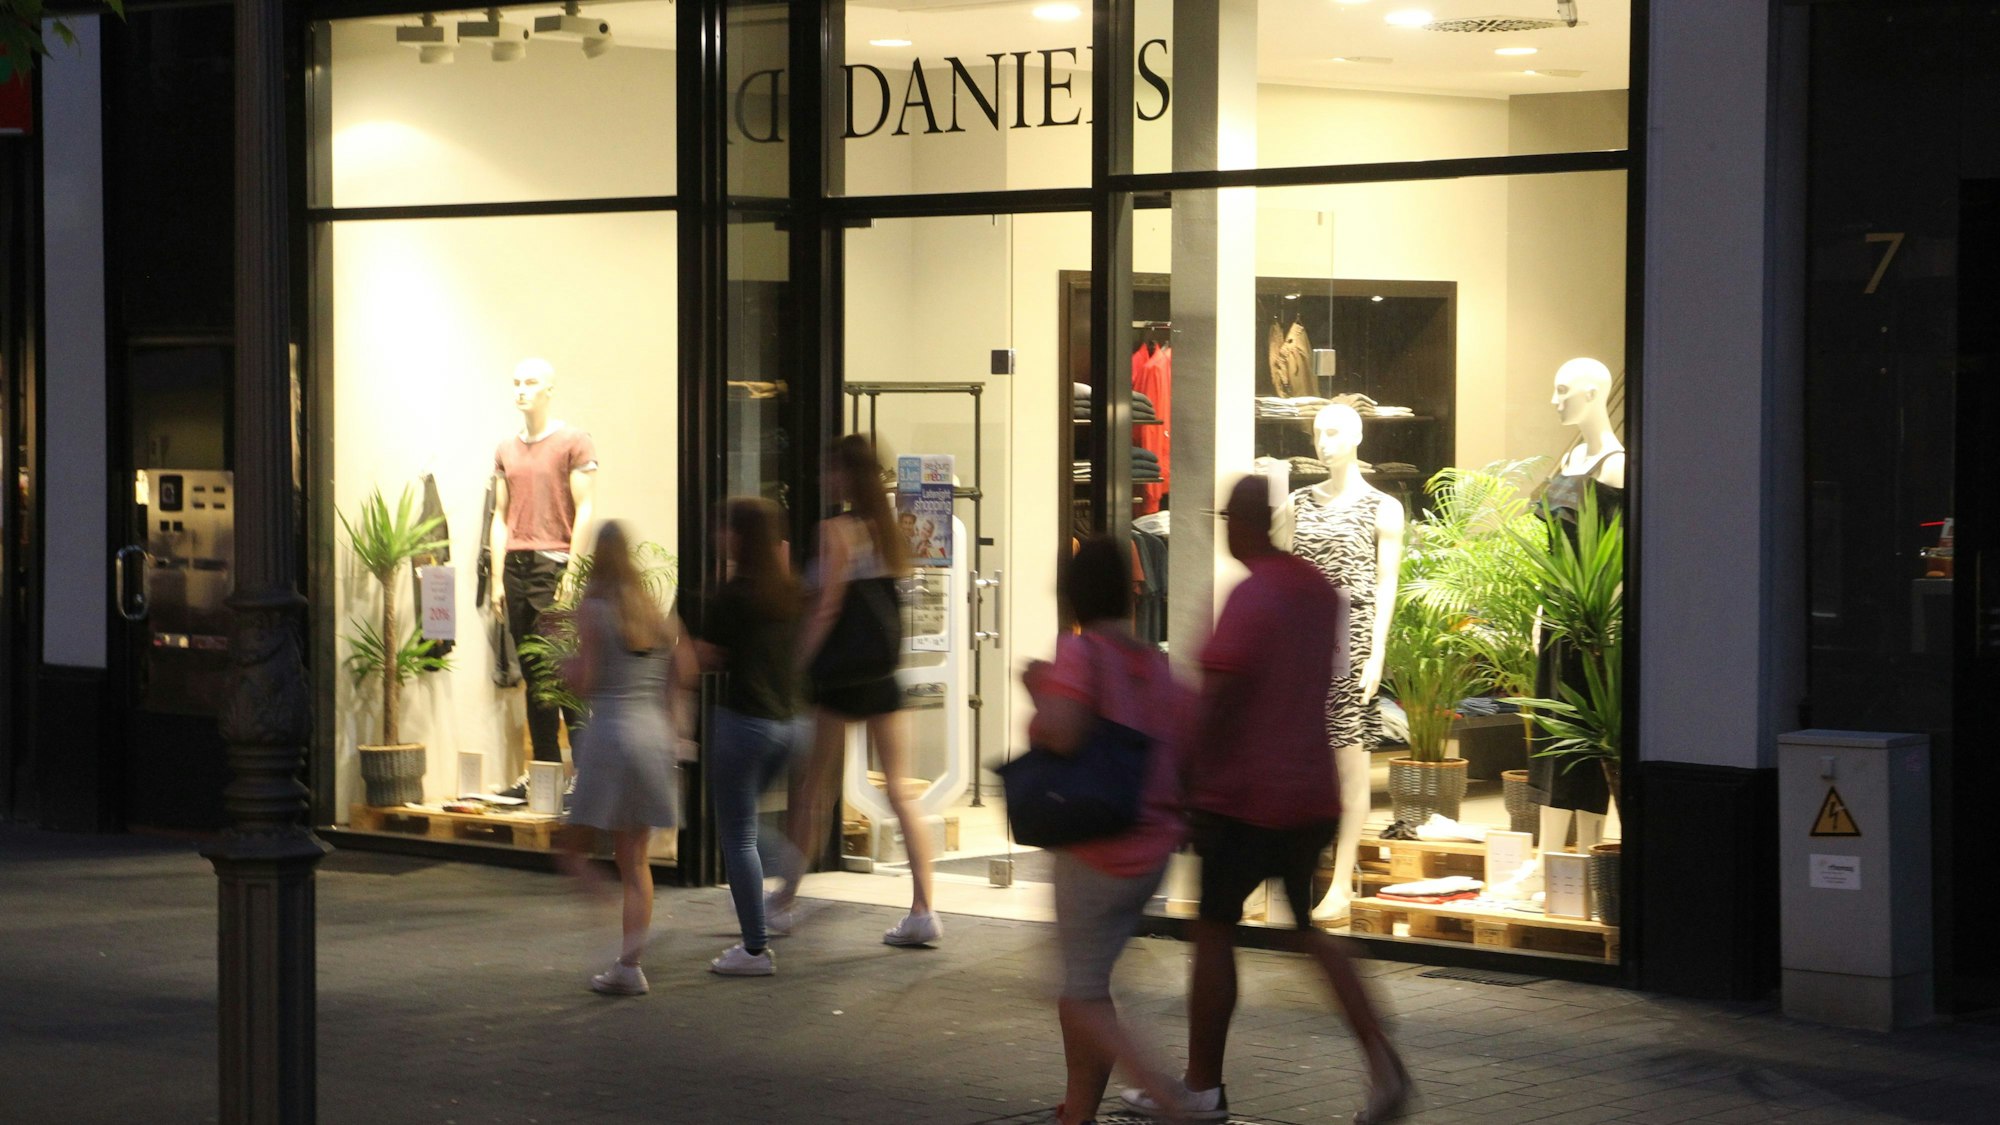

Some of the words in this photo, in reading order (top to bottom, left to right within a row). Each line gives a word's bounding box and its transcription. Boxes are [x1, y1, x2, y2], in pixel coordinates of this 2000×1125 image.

[840, 39, 1170, 138] DANIES
[1865, 233, 1904, 293] 7
[914, 497, 951, 515] shopping
